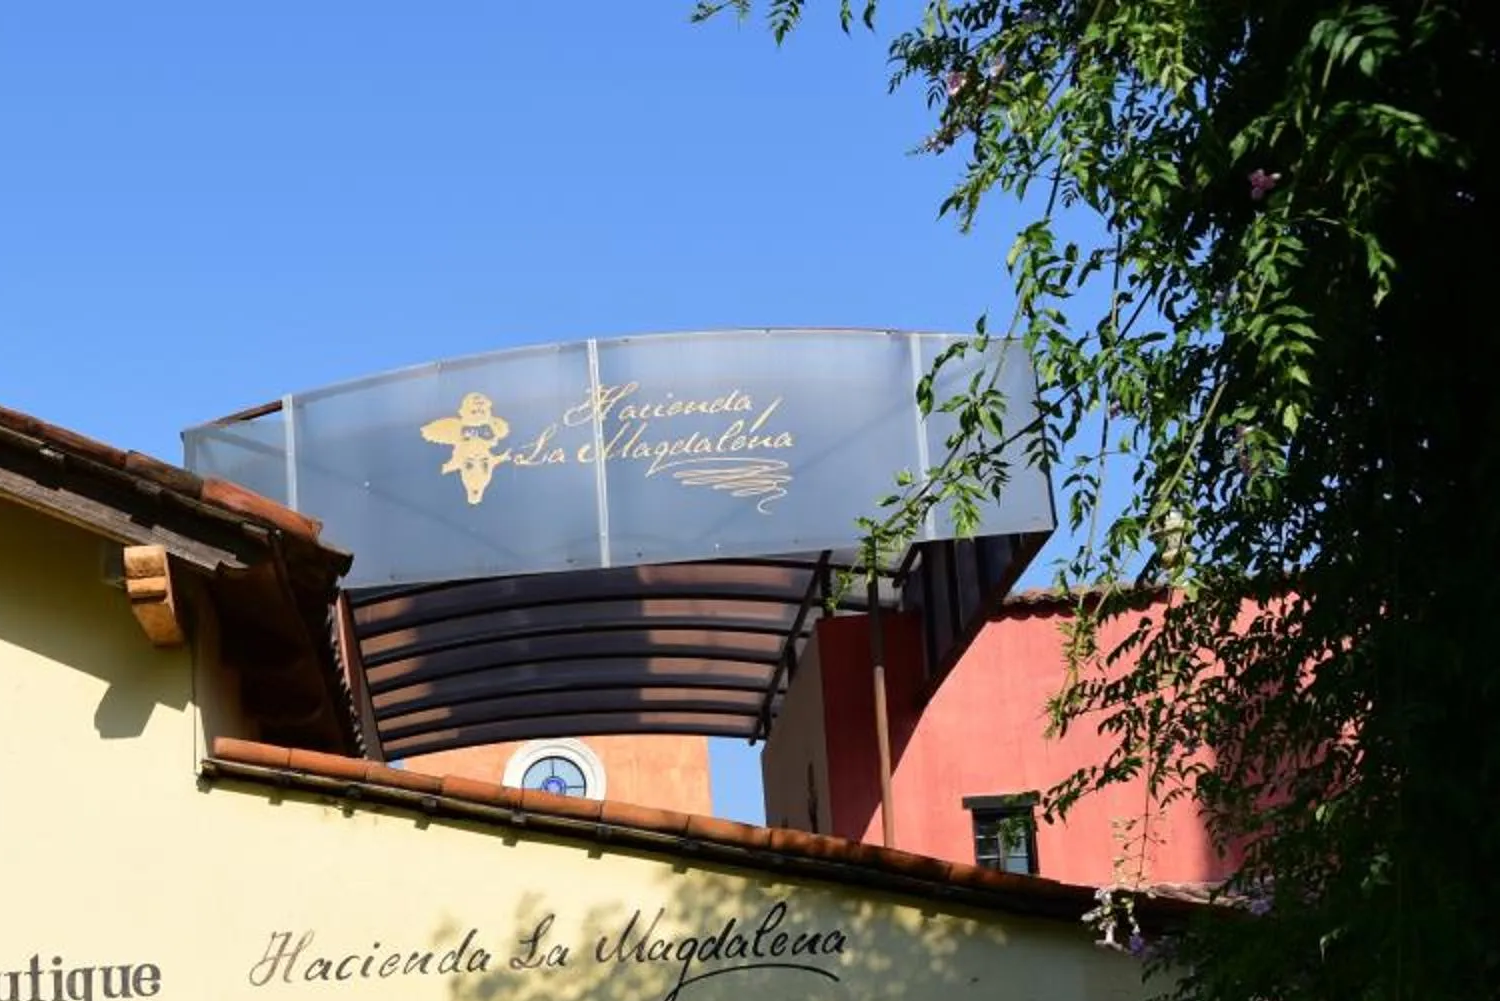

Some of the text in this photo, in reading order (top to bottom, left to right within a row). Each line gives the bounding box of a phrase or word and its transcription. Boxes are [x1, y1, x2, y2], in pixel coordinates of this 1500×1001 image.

[563, 381, 752, 427] Hacienda
[514, 417, 794, 478] La Magdalena
[249, 928, 492, 987] Hacienda
[509, 913, 569, 970] La
